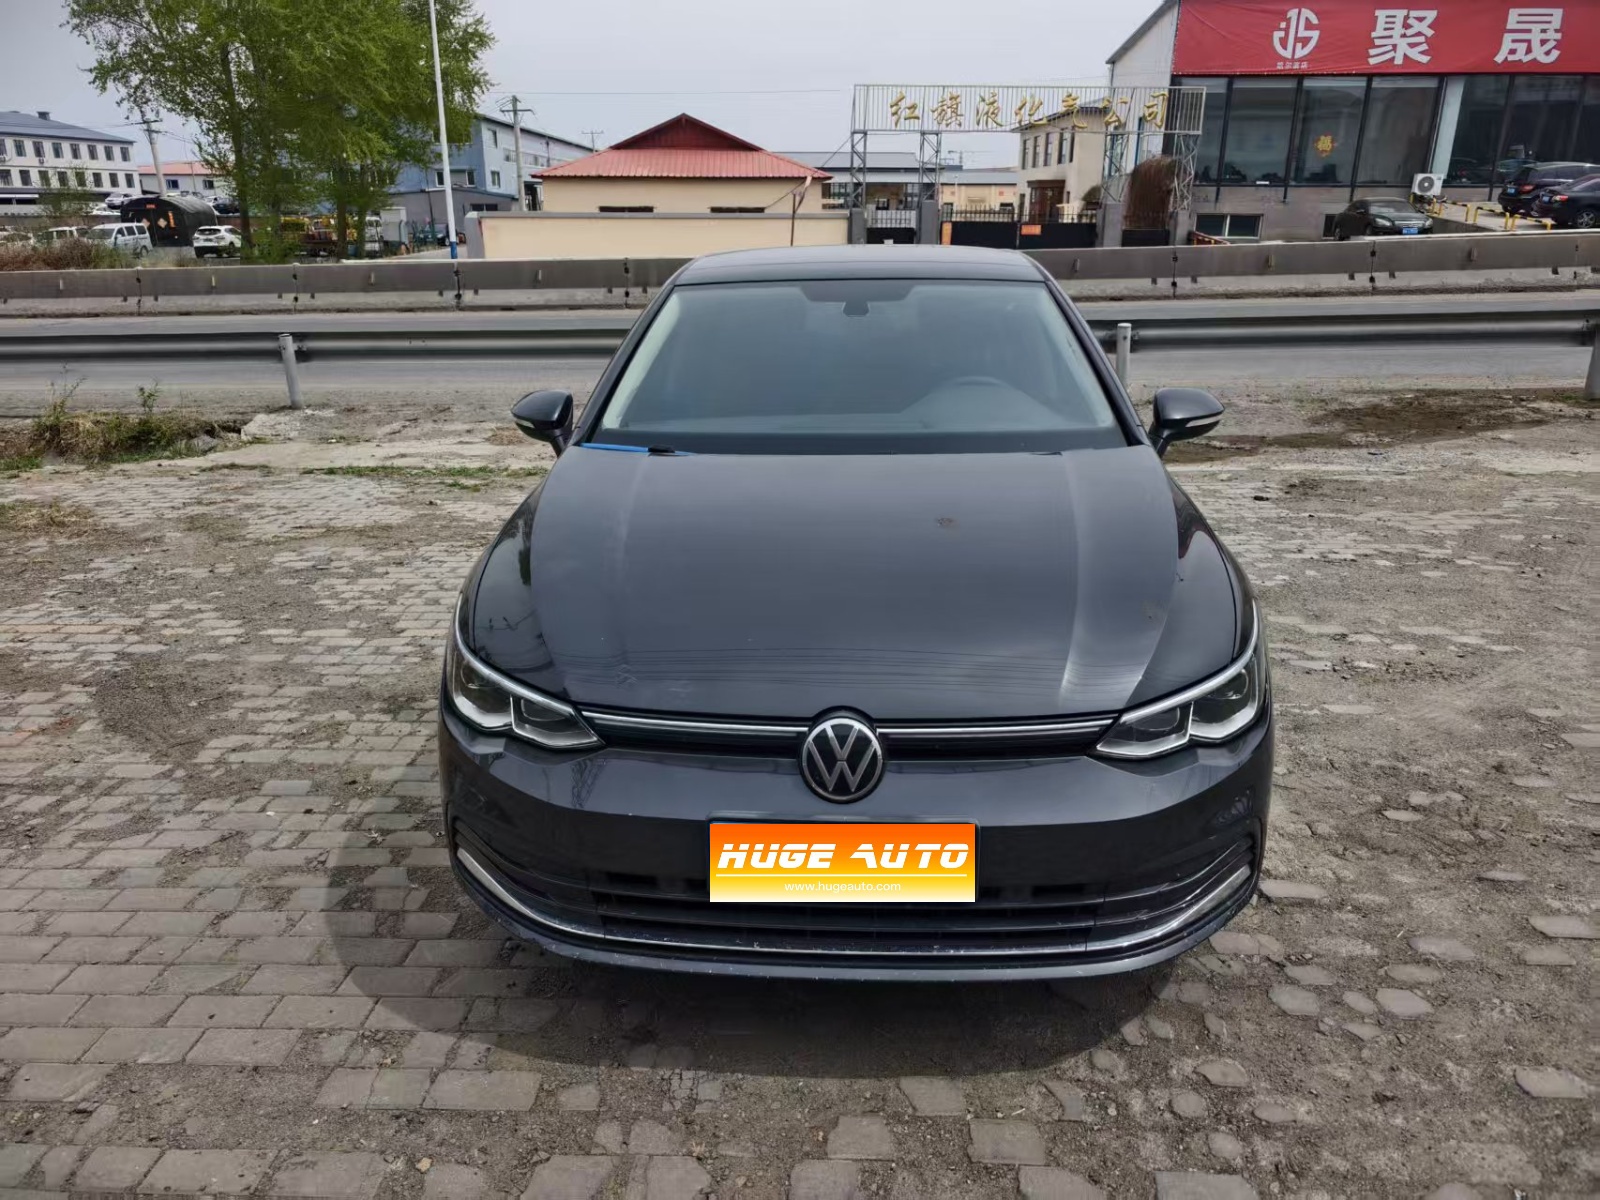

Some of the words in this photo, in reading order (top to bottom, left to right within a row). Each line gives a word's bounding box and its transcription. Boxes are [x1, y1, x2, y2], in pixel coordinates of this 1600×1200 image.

[1368, 8, 1564, 65] 聚晟
[889, 91, 1170, 129] 红旗液化气公司
[805, 721, 879, 795] VW
